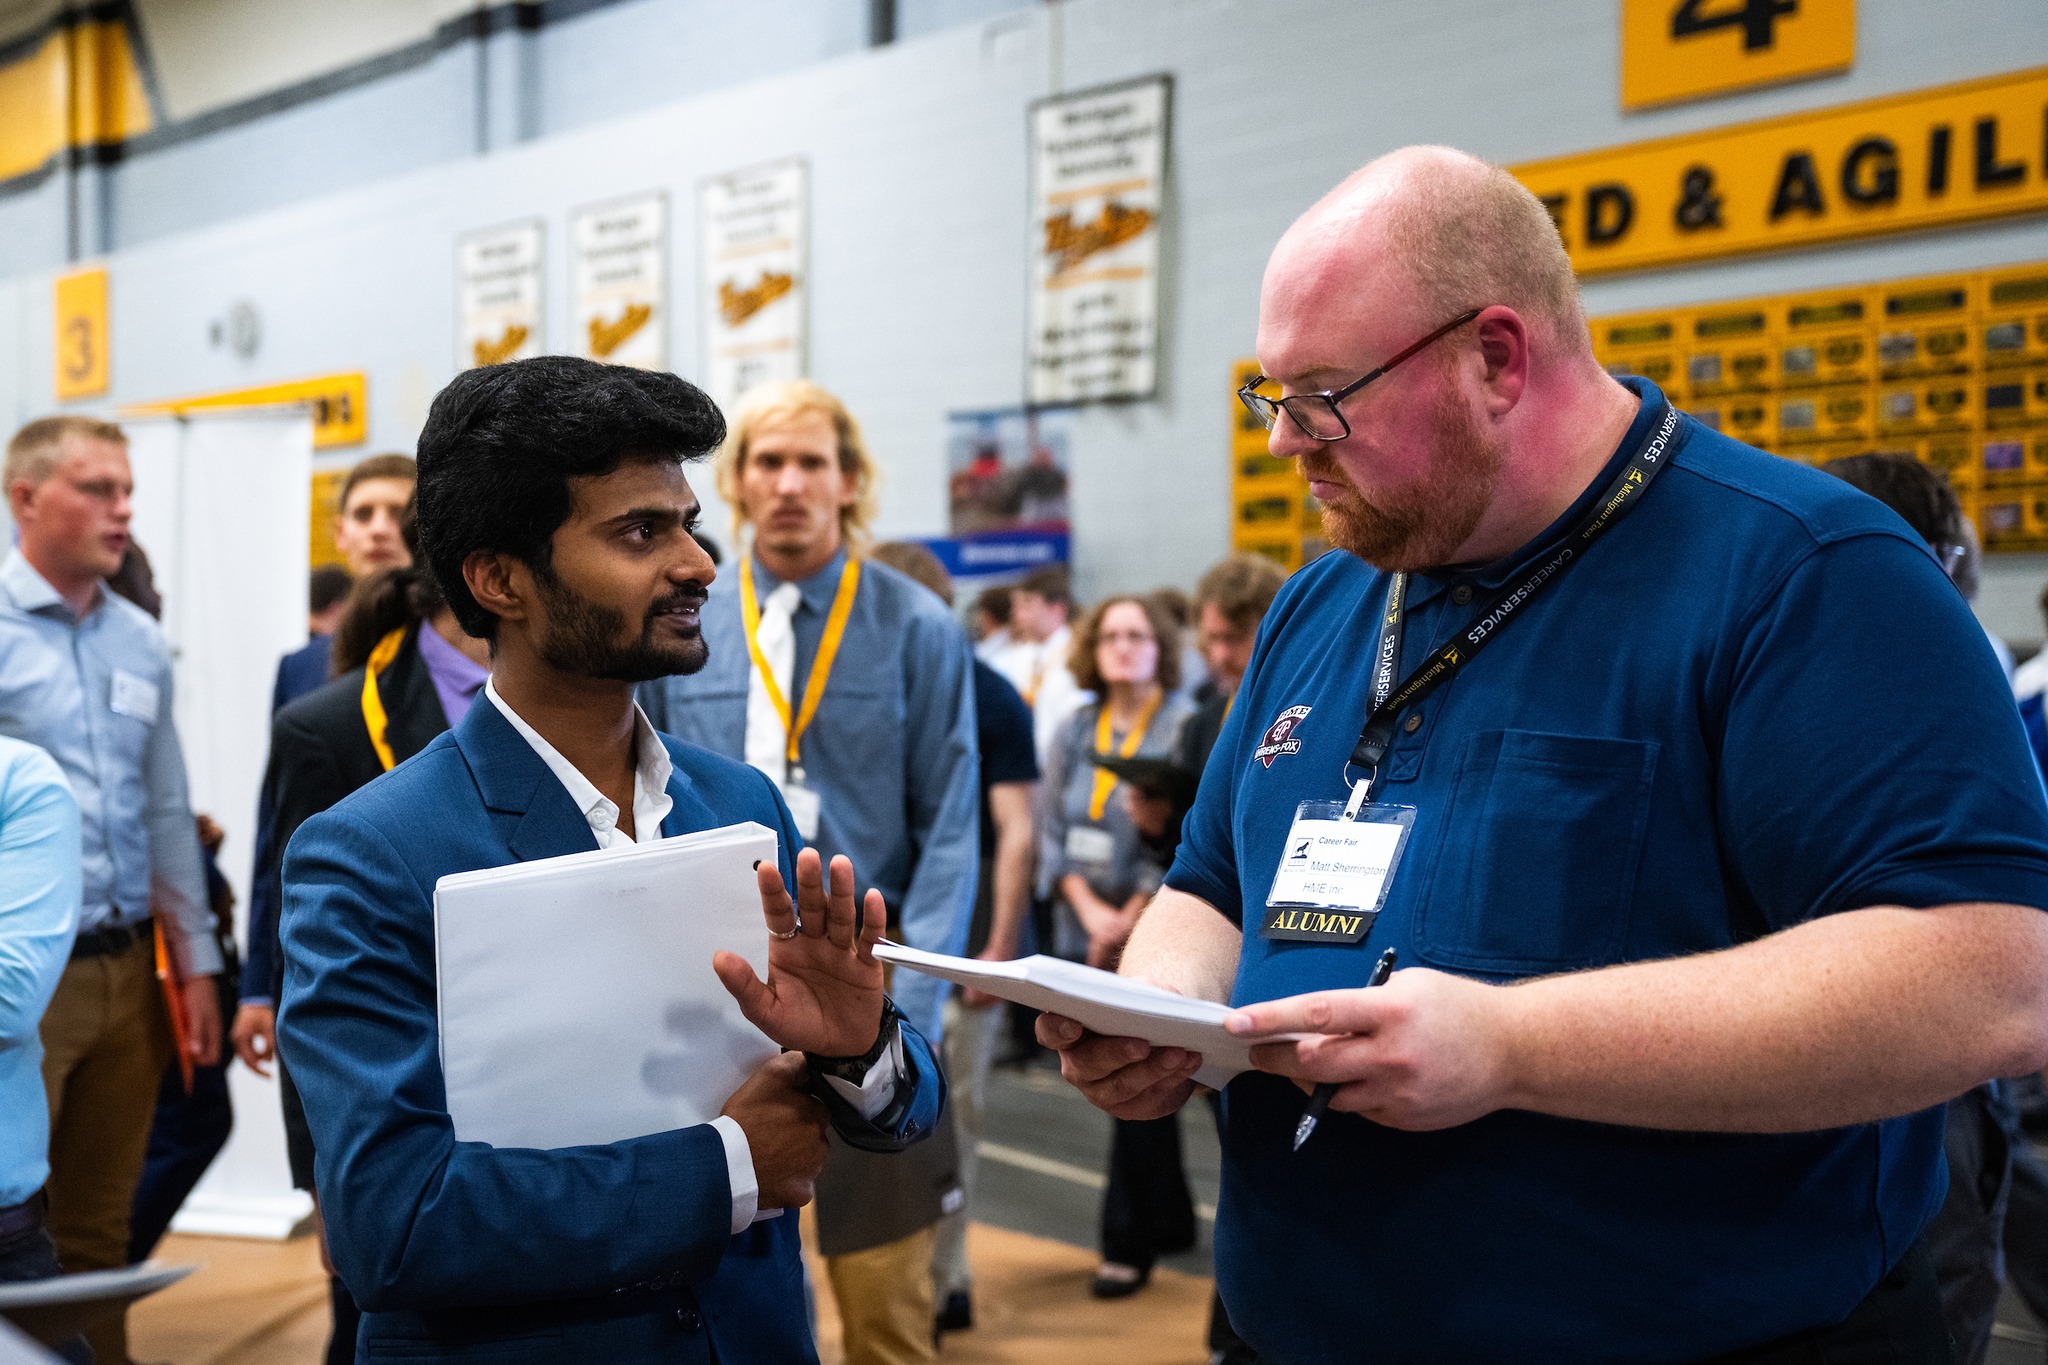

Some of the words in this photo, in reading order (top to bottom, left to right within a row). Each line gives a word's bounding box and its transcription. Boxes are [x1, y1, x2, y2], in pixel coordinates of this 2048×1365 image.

[1673, 163, 1723, 232] &
[1600, 482, 1634, 521] Michigan
[1582, 519, 1604, 539] Tech
[1467, 549, 1573, 645] CAREERSERVICES
[1405, 661, 1446, 696] Michigan
[1387, 692, 1408, 711] Tech
[1318, 837, 1342, 846] Career
[1343, 838, 1358, 846] Fair
[1310, 861, 1330, 872] Matt
[1332, 862, 1386, 877] Sherrington
[1303, 882, 1327, 894] HME
[1270, 910, 1363, 935] ALUMNI
